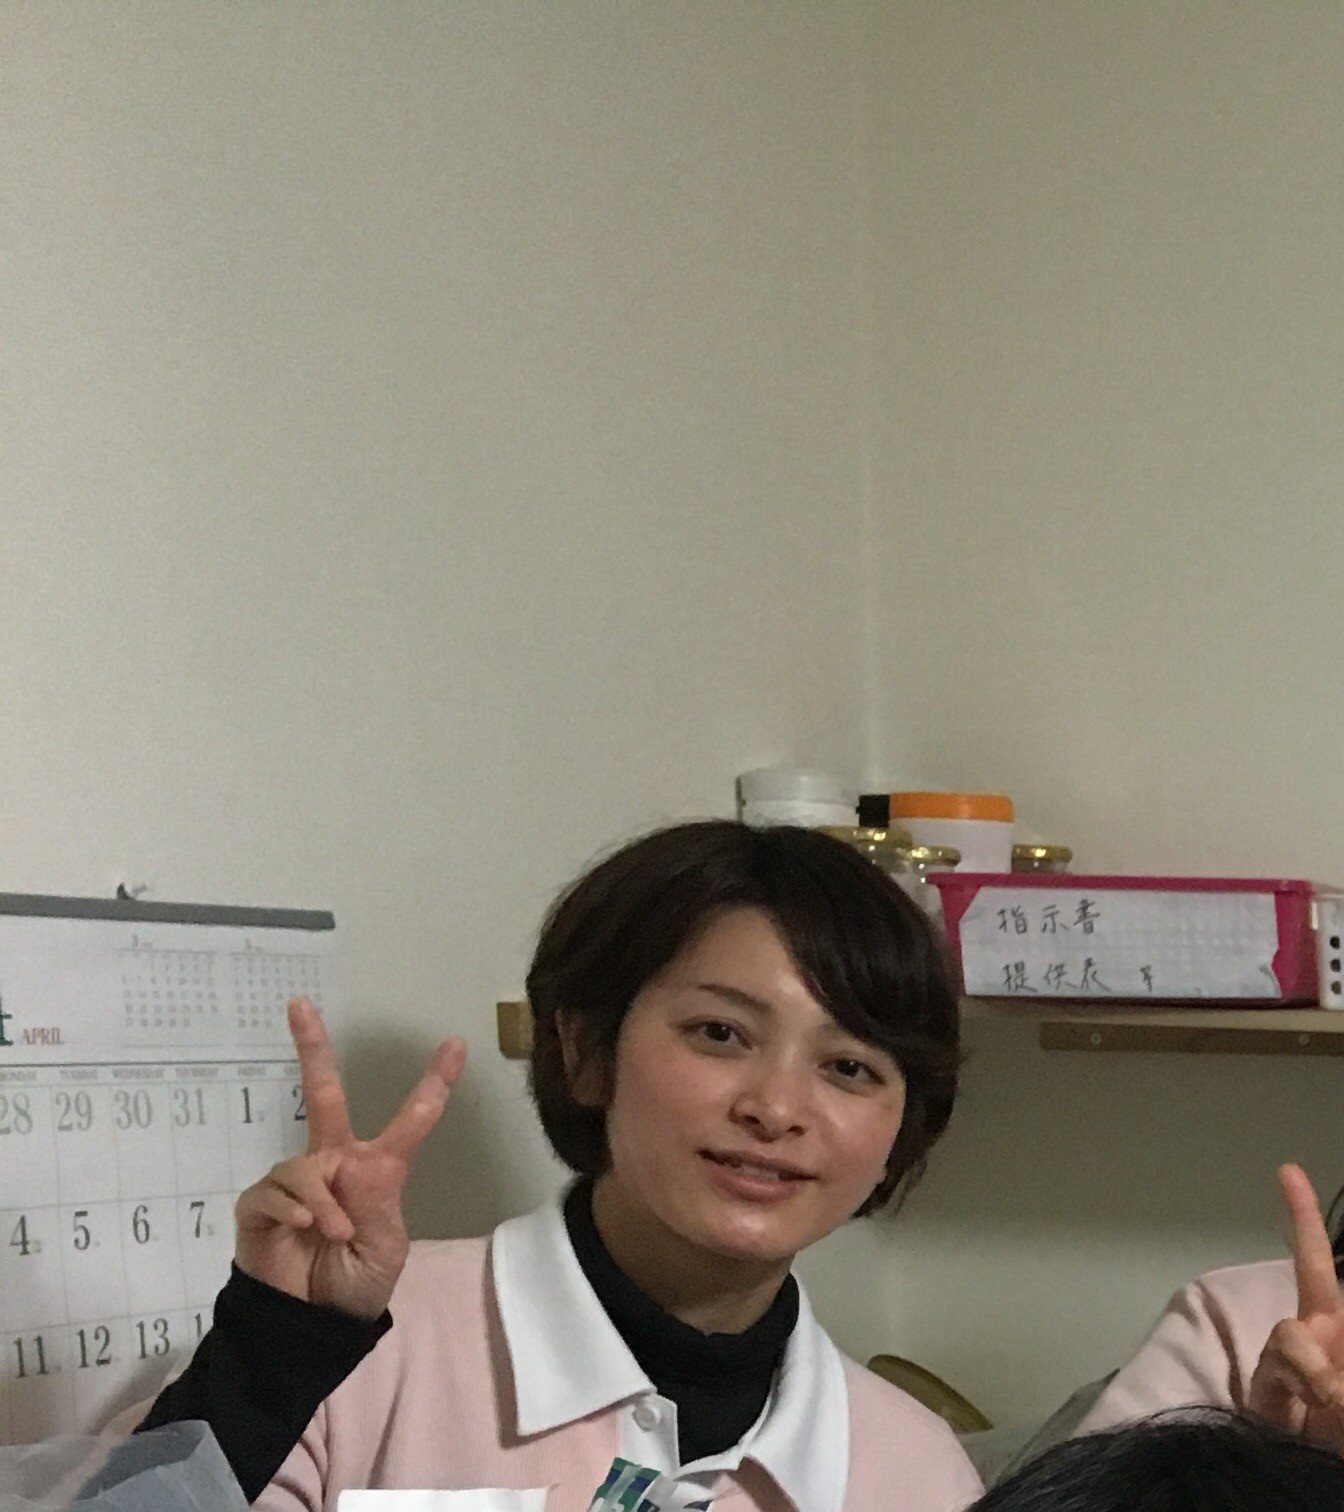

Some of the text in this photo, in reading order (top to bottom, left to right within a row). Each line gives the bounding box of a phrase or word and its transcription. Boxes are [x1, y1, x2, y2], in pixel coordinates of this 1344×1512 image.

[55, 1089, 93, 1132] 29
[115, 1087, 153, 1130] 30
[173, 1087, 207, 1128] 31
[241, 1085, 253, 1125] 1
[9, 1200, 206, 1256] 4 5 6 7
[13, 1334, 50, 1380] 11
[75, 1324, 112, 1369] 12
[134, 1317, 171, 1360] 13
